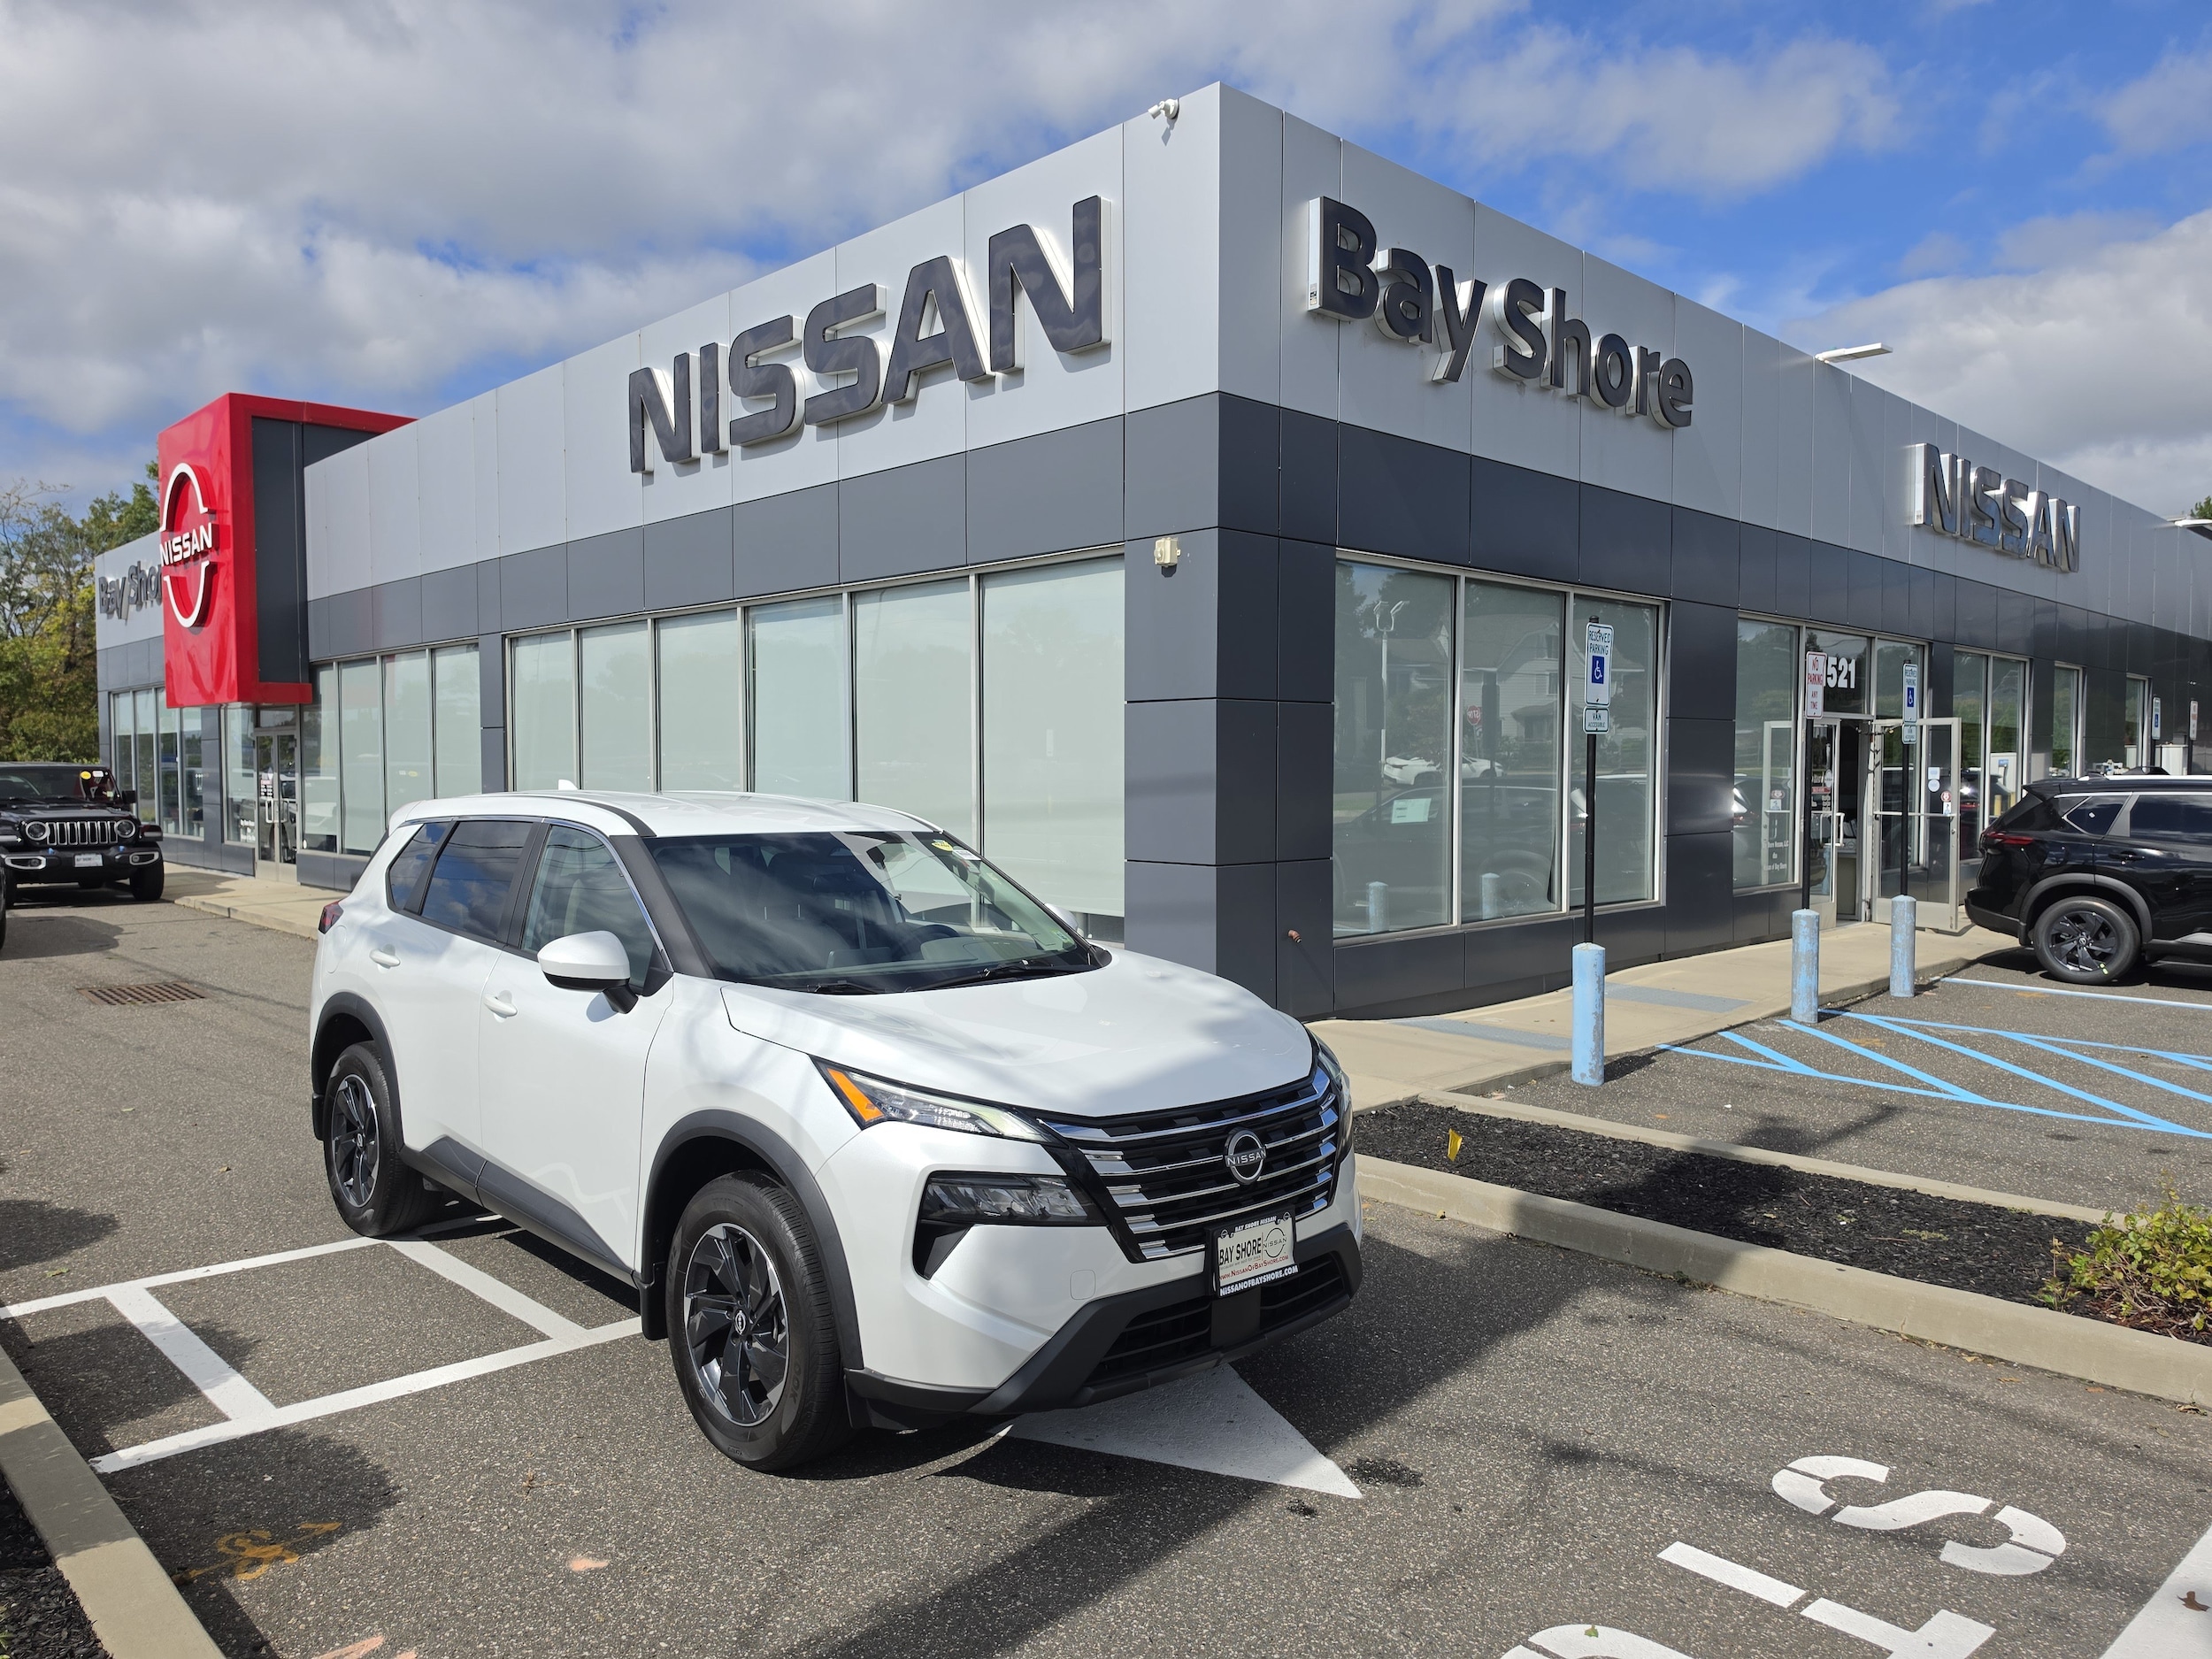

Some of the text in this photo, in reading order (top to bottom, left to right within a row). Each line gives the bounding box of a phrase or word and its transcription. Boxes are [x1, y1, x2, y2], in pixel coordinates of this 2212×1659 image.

[1308, 196, 1694, 429] Bay Shore
[629, 195, 1110, 473] NISSAN
[1914, 442, 2081, 573] NISSAN
[159, 522, 212, 567] NISSAN
[99, 560, 163, 620] Bay Shor
[1589, 629, 1611, 644] RESERVED
[1589, 642, 1609, 656] PARKING
[1811, 658, 1819, 672] NO
[1824, 657, 1855, 688] 521
[1808, 673, 1824, 686] PARKING
[1593, 711, 1601, 721] VAN
[1226, 1149, 1267, 1167] NISSAN
[1234, 1216, 1277, 1233] BAY SHORE NISSAN
[1219, 1245, 1234, 1266] BAY
[1236, 1237, 1262, 1261] SHORE
[1263, 1237, 1287, 1249] NISSAN
[1219, 1265, 1299, 1297] NISSANOFBAYSHORE.COM
